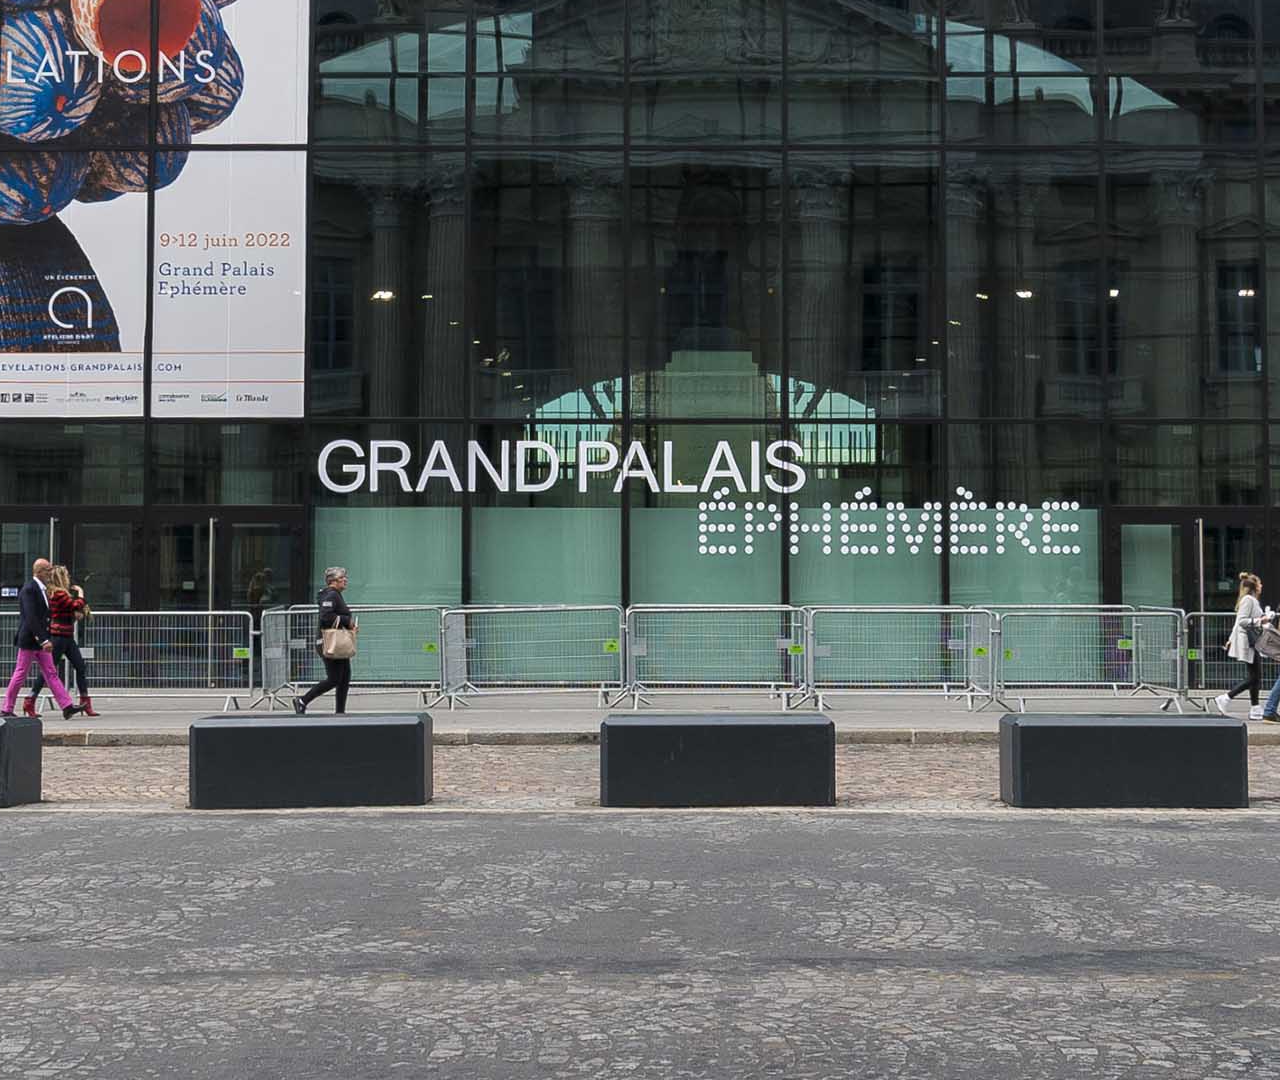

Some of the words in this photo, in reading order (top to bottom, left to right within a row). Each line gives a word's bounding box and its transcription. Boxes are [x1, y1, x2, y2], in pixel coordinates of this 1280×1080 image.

[202, 233, 239, 251] juin
[245, 232, 290, 248] 2022
[158, 260, 214, 276] Grand
[220, 260, 275, 276] Palais
[158, 279, 247, 299] Ephémère
[317, 439, 560, 494] GRAND
[577, 439, 807, 494] PALAIS
[697, 486, 1081, 555] ÉPHÉMÈRE
